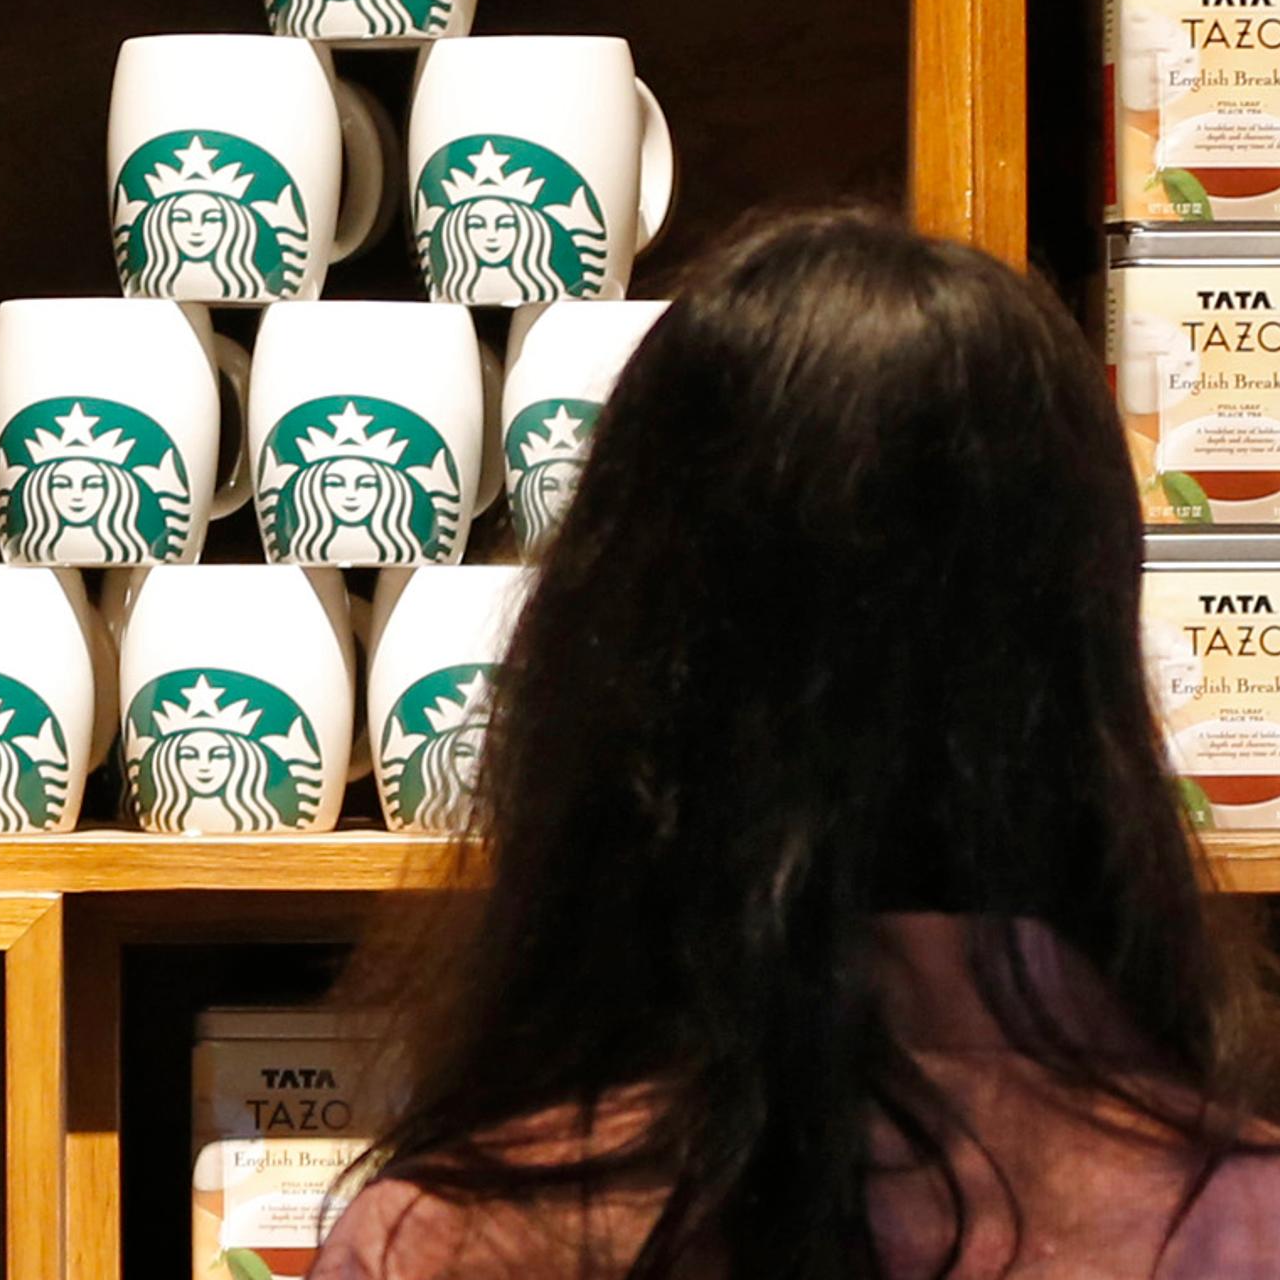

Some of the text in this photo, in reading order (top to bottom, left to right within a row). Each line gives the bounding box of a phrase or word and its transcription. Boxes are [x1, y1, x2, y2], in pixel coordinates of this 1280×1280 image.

[1169, 69, 1229, 92] English
[1197, 291, 1272, 309] TATA
[1169, 372, 1229, 395] English
[1198, 595, 1274, 614] TATA
[1171, 676, 1231, 700] English
[261, 1069, 336, 1088] TATA
[246, 1099, 352, 1131] TAZO
[233, 1151, 293, 1173] English
